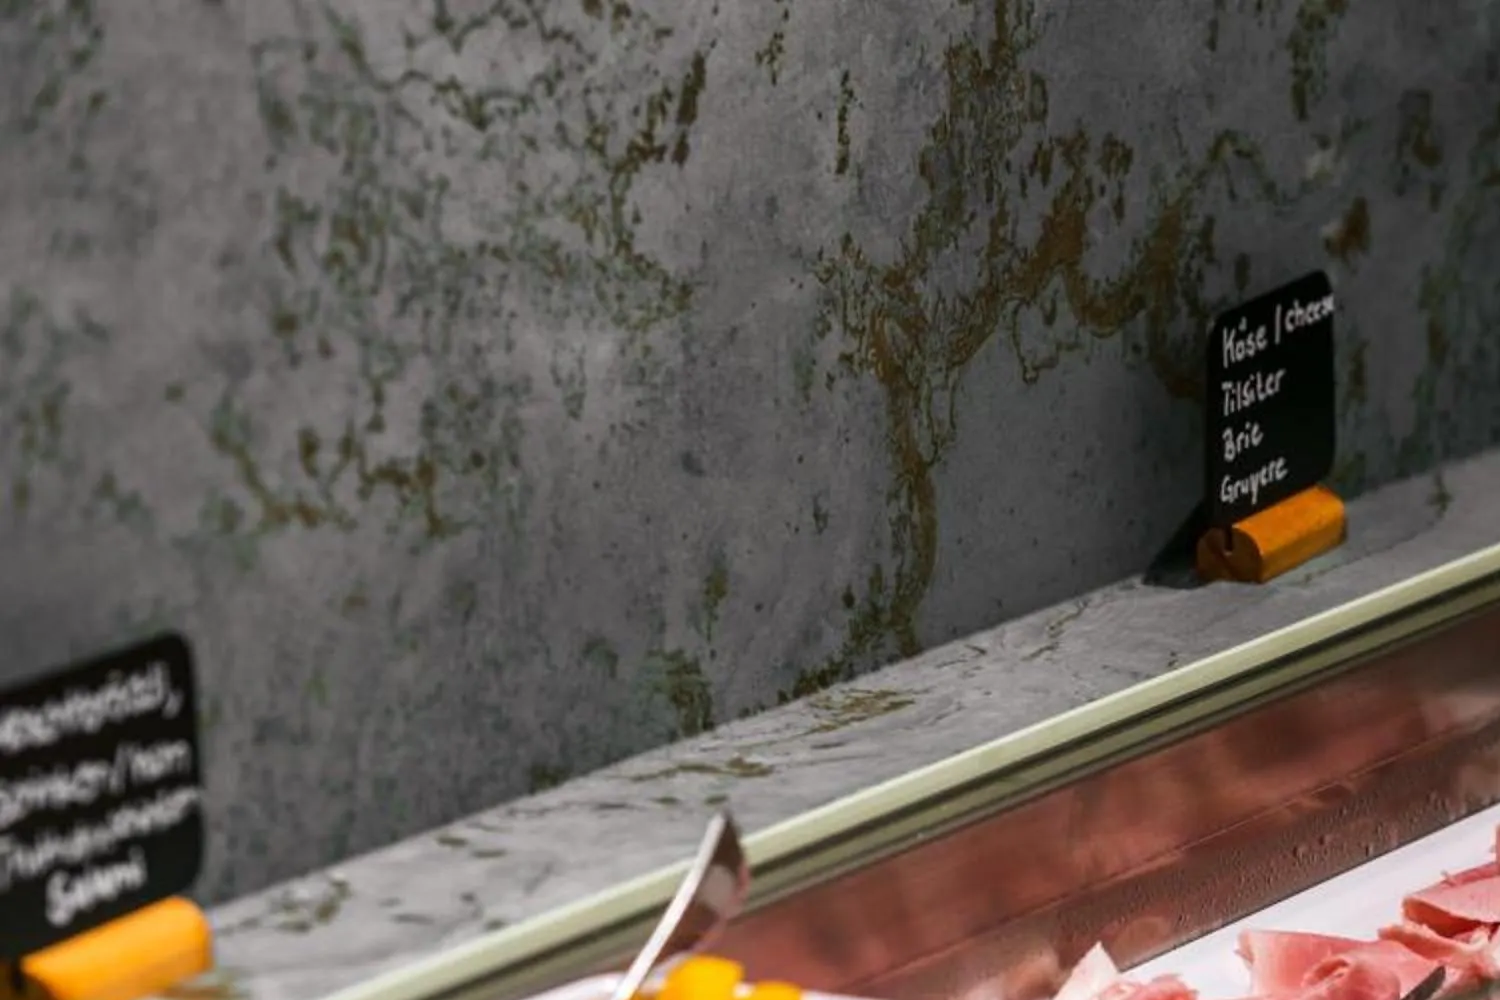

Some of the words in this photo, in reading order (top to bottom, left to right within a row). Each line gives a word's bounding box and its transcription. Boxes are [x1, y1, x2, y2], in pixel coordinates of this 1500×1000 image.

[1221, 368, 1286, 417] Tilsiter
[1222, 422, 1264, 461] Brie
[1220, 456, 1289, 505] Gruyere
